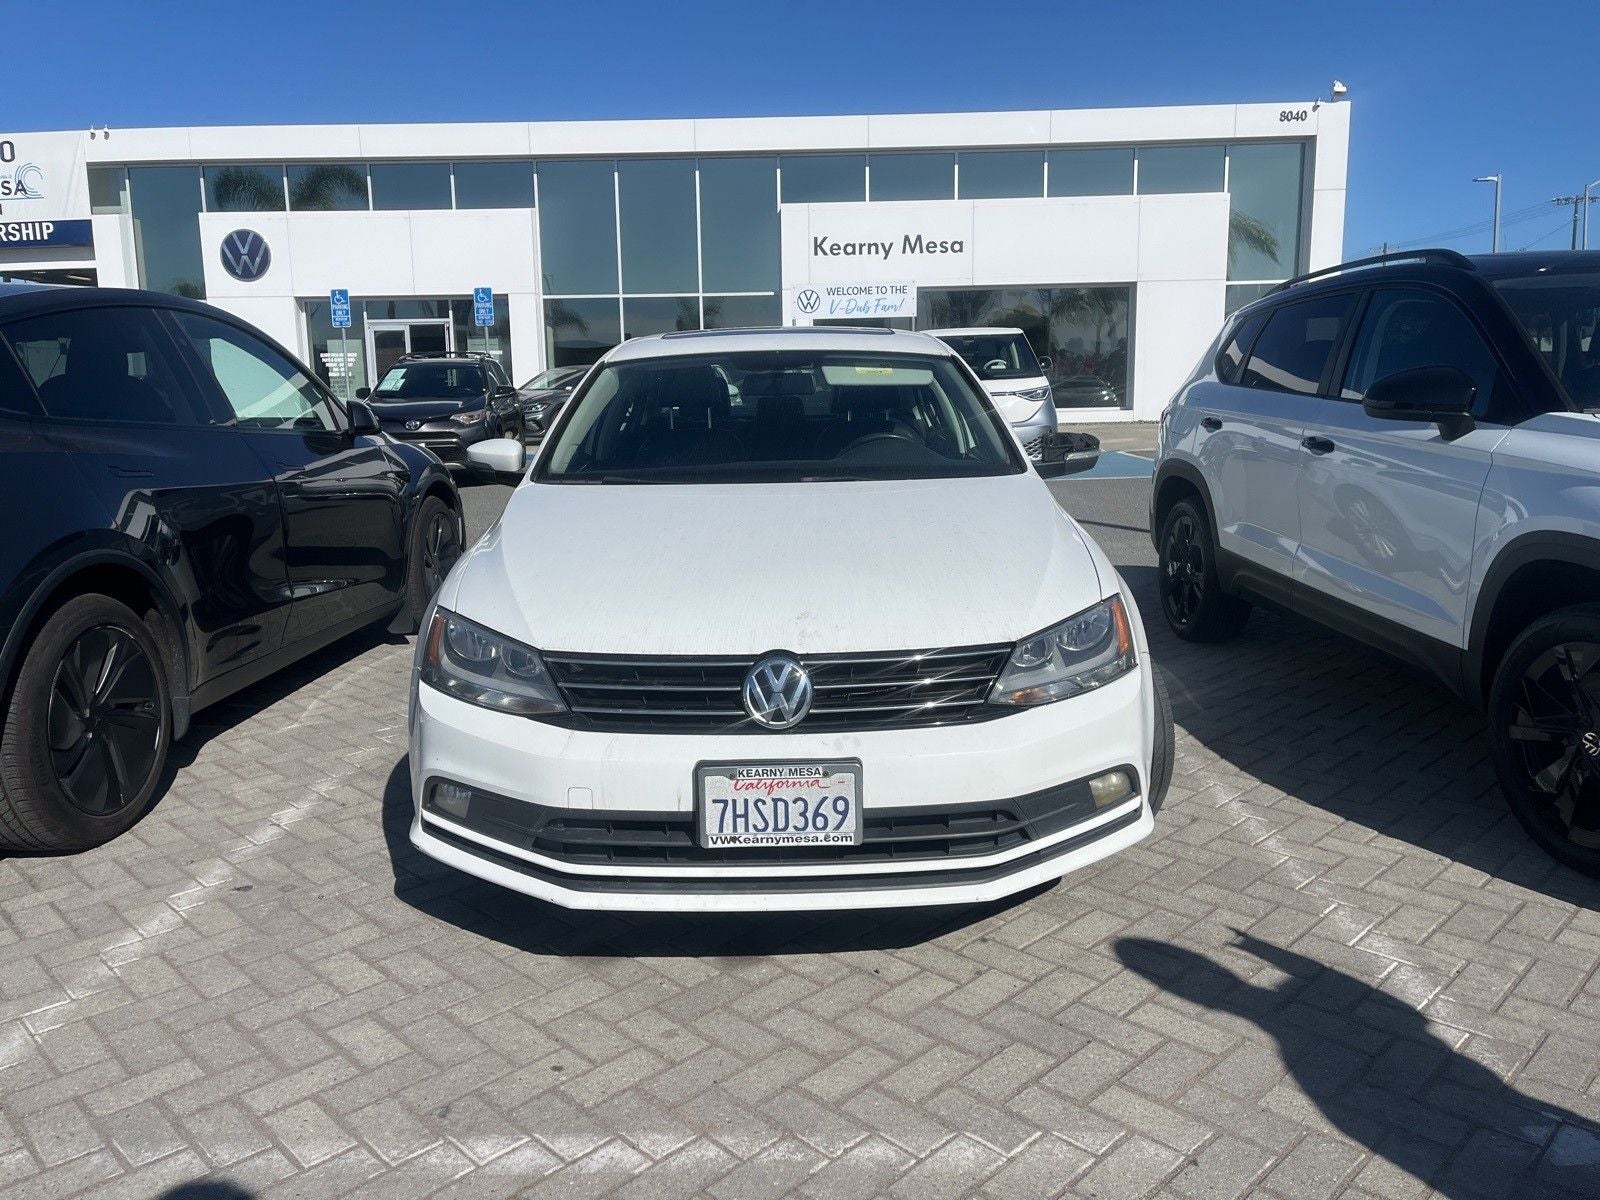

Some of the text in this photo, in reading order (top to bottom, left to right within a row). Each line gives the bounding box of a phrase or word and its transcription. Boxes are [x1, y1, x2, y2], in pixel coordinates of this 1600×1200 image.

[1279, 110, 1308, 122] 8040
[220, 229, 271, 282] VW
[813, 234, 964, 260] Kearny Mesa
[826, 285, 908, 296] WELCOME TO THE
[796, 289, 821, 314] VW
[828, 297, 905, 315] V-Dub Fam!
[742, 656, 812, 729] VW
[737, 767, 822, 778] KEARNY MESA
[733, 778, 831, 796] California
[711, 795, 850, 834] 7HSD369
